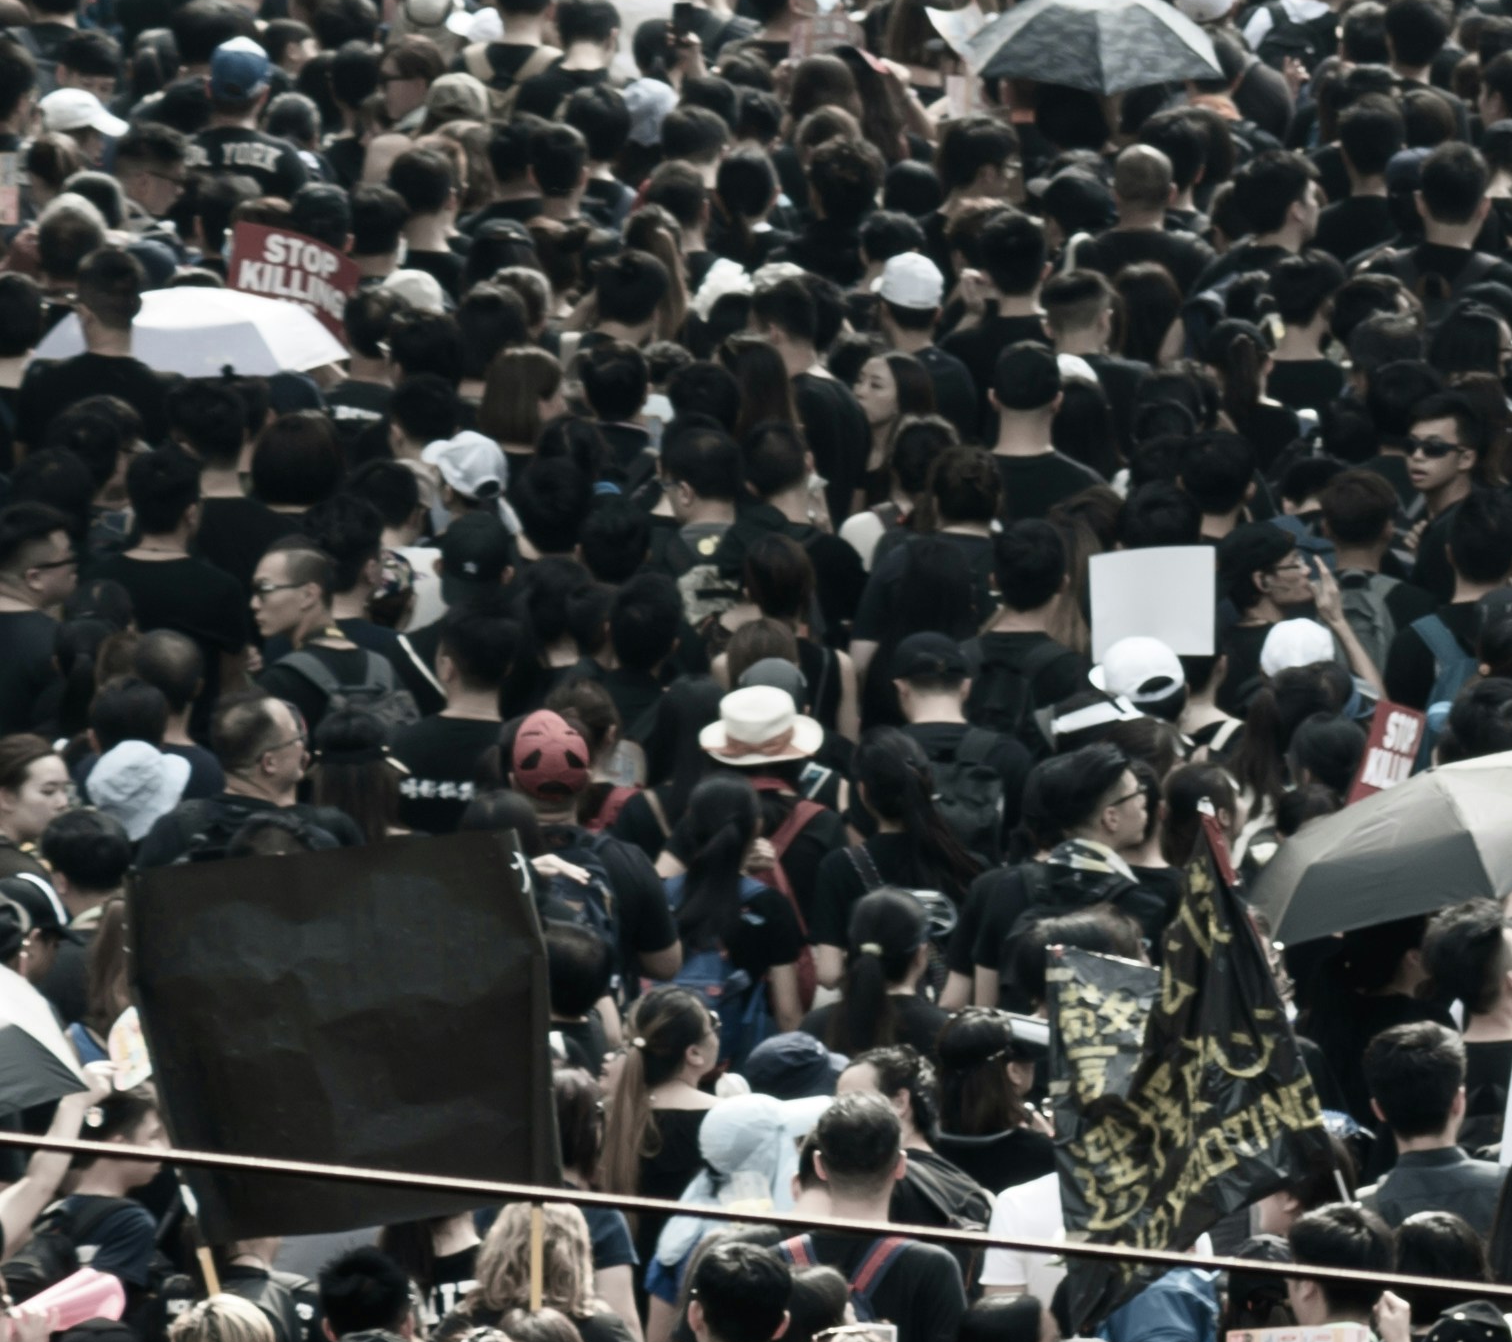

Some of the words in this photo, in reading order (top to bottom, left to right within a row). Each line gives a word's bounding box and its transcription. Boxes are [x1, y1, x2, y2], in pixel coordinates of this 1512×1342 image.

[221, 141, 283, 173] YORK
[263, 234, 339, 276] STOP
[238, 259, 346, 319] KILLING
